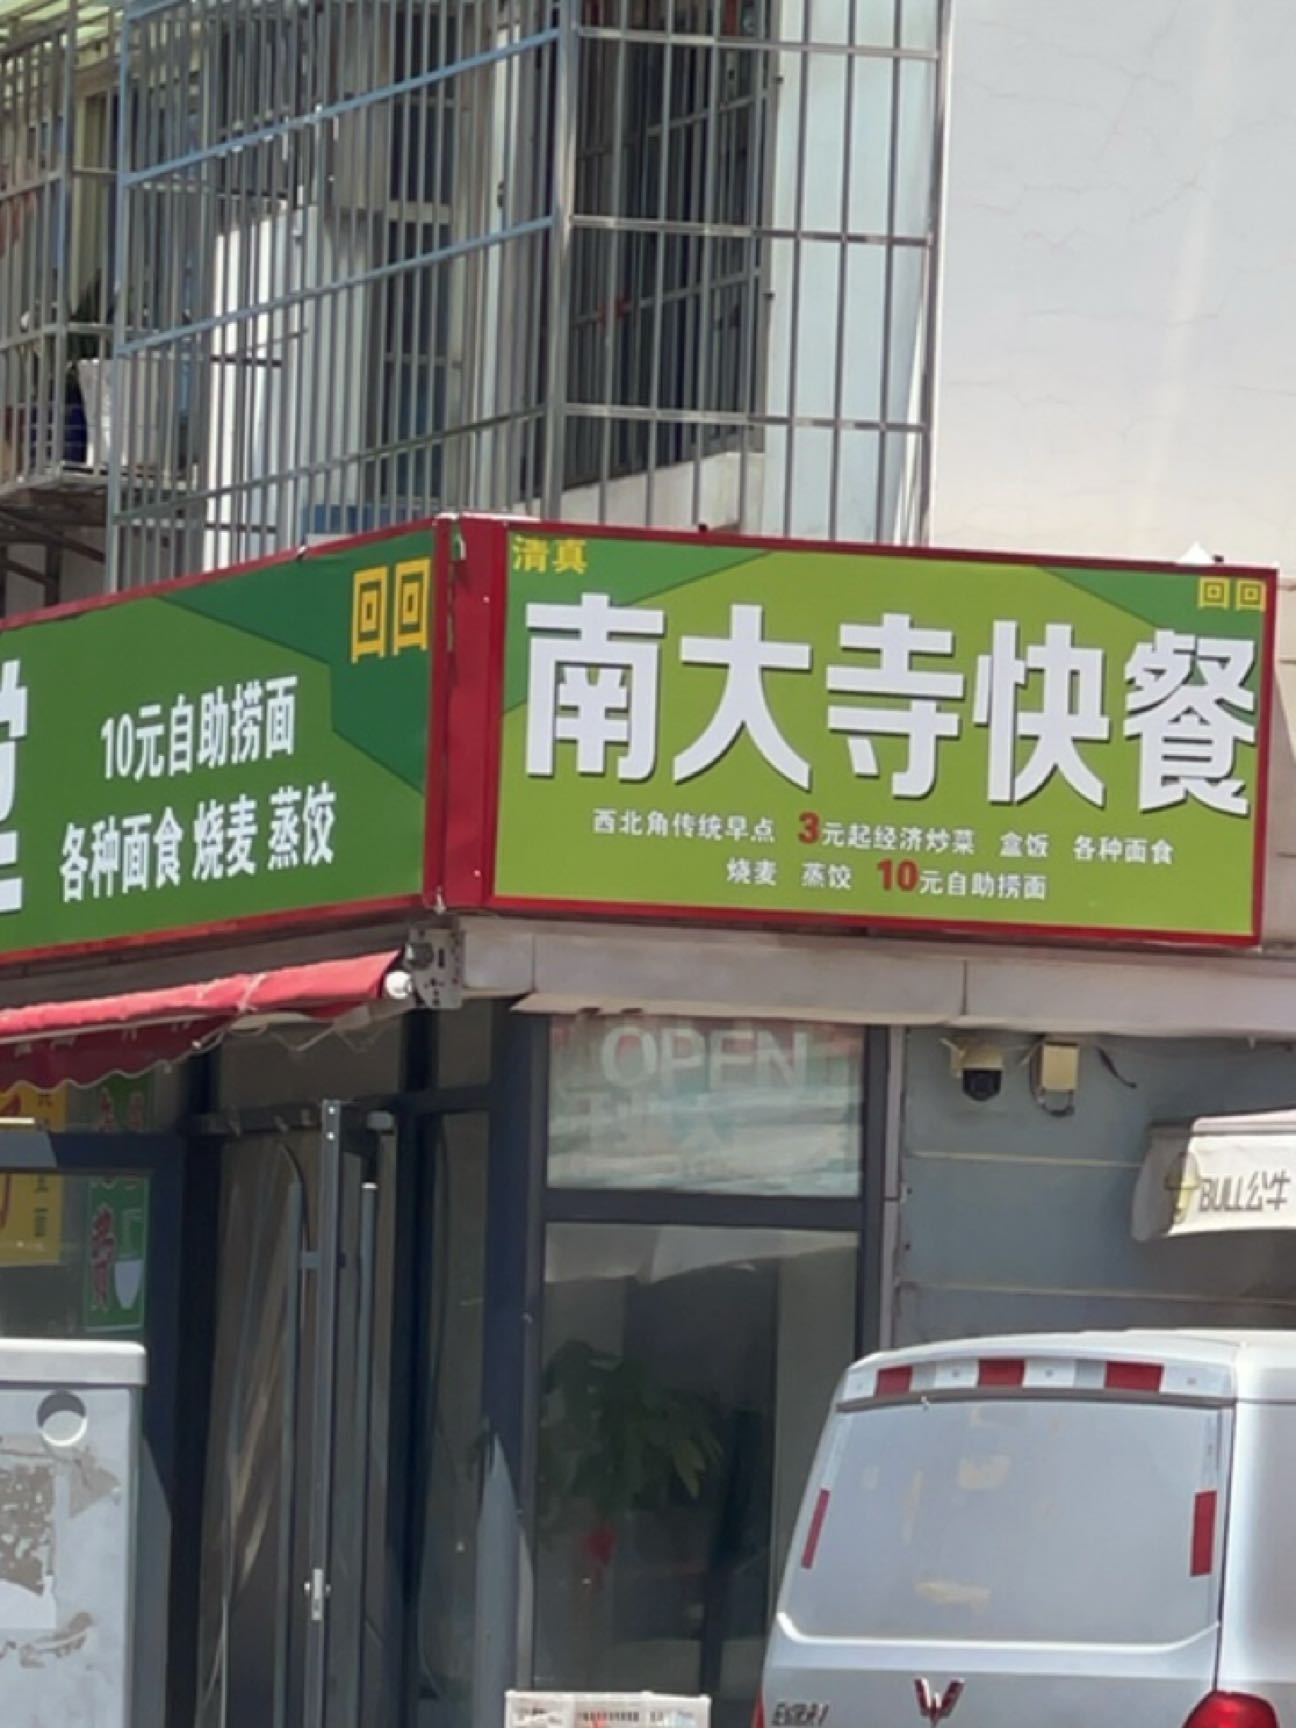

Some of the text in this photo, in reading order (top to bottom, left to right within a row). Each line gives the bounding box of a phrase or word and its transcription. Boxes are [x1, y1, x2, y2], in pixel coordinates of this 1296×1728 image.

[510, 536, 589, 575] 清真
[101, 675, 299, 781] 10元自助捞面
[524, 592, 1259, 816] 南大寺快餐
[59, 782, 337, 902] 各种面食 烧麦 蒸饺
[592, 808, 1175, 865] 西北角传统早点 3元起经济炒菜 盒饭 各种面食
[726, 857, 1047, 901] 烧麦 蒸饺 10元自助捞面
